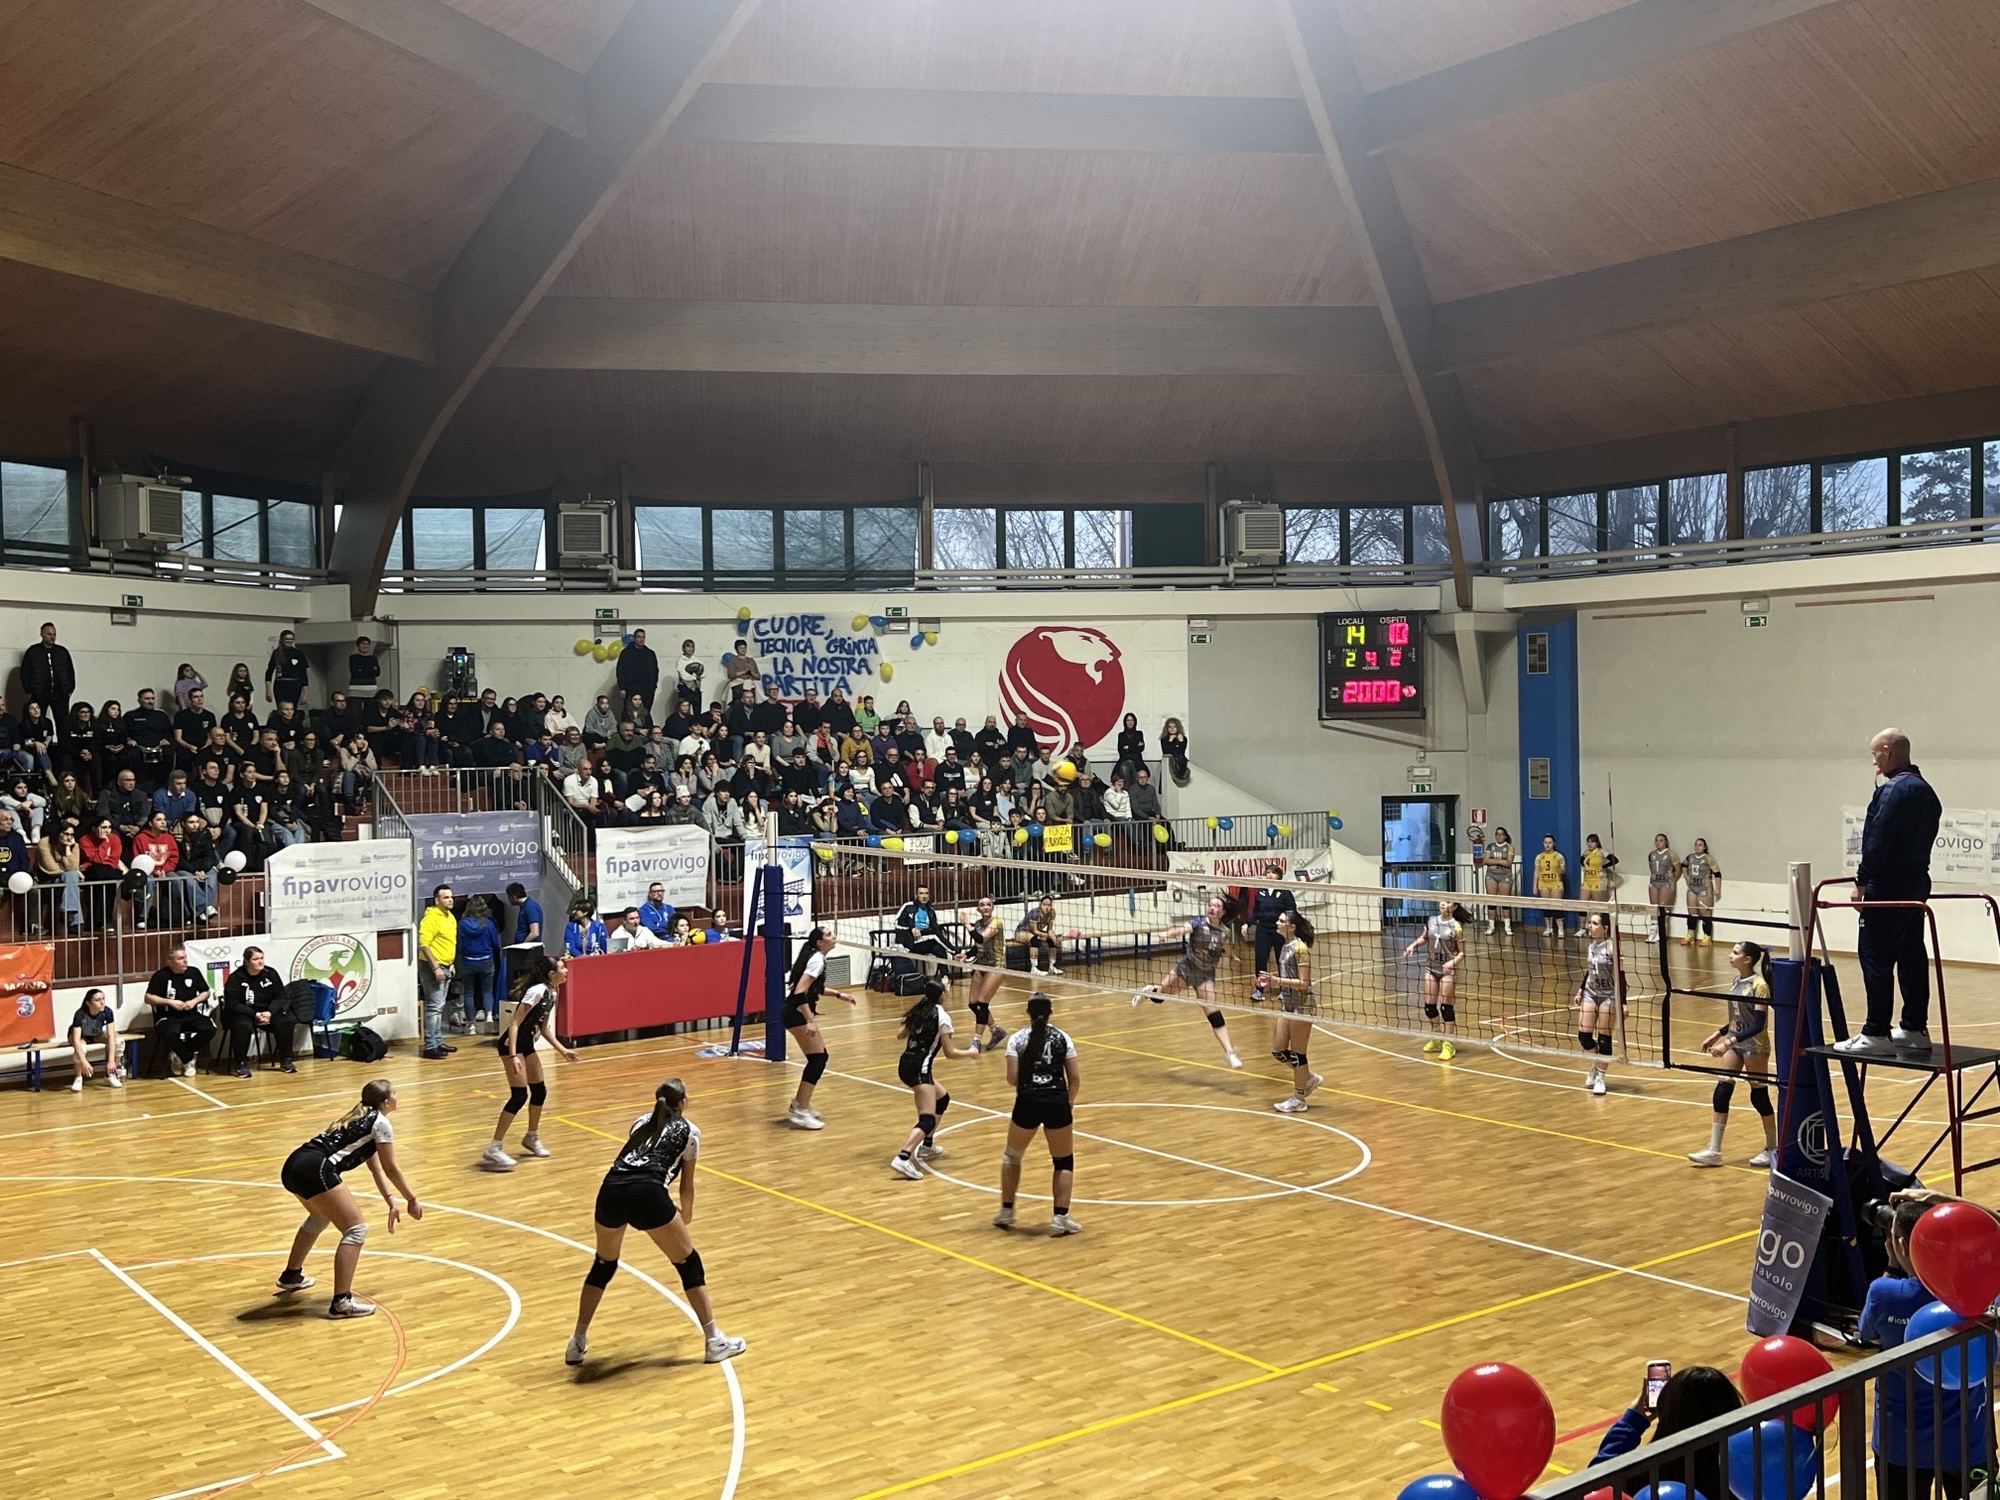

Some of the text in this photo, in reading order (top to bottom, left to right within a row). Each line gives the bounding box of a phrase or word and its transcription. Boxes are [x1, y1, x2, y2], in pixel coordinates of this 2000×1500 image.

[754, 615, 834, 640] CUORE,
[1337, 617, 1364, 626] LOCALI
[1379, 615, 1407, 624] OSPITI
[1346, 625, 1366, 645] 14
[1388, 623, 1409, 645] 10
[753, 637, 815, 657] TECNICA
[772, 655, 873, 676] LA NOSTRA
[1345, 652, 1356, 668] 2
[1365, 651, 1378, 667] 4
[1390, 651, 1402, 668] 2
[431, 839, 539, 863] fipavrovigo
[1935, 834, 1984, 854] ovigo
[605, 853, 706, 877] fipavrovigo
[750, 849, 808, 861] fiprovigo
[1310, 868, 1329, 876] CONI
[1545, 861, 1551, 871] 3
[282, 871, 407, 900] fipavrovigo
[1042, 1041, 1053, 1064] 4
